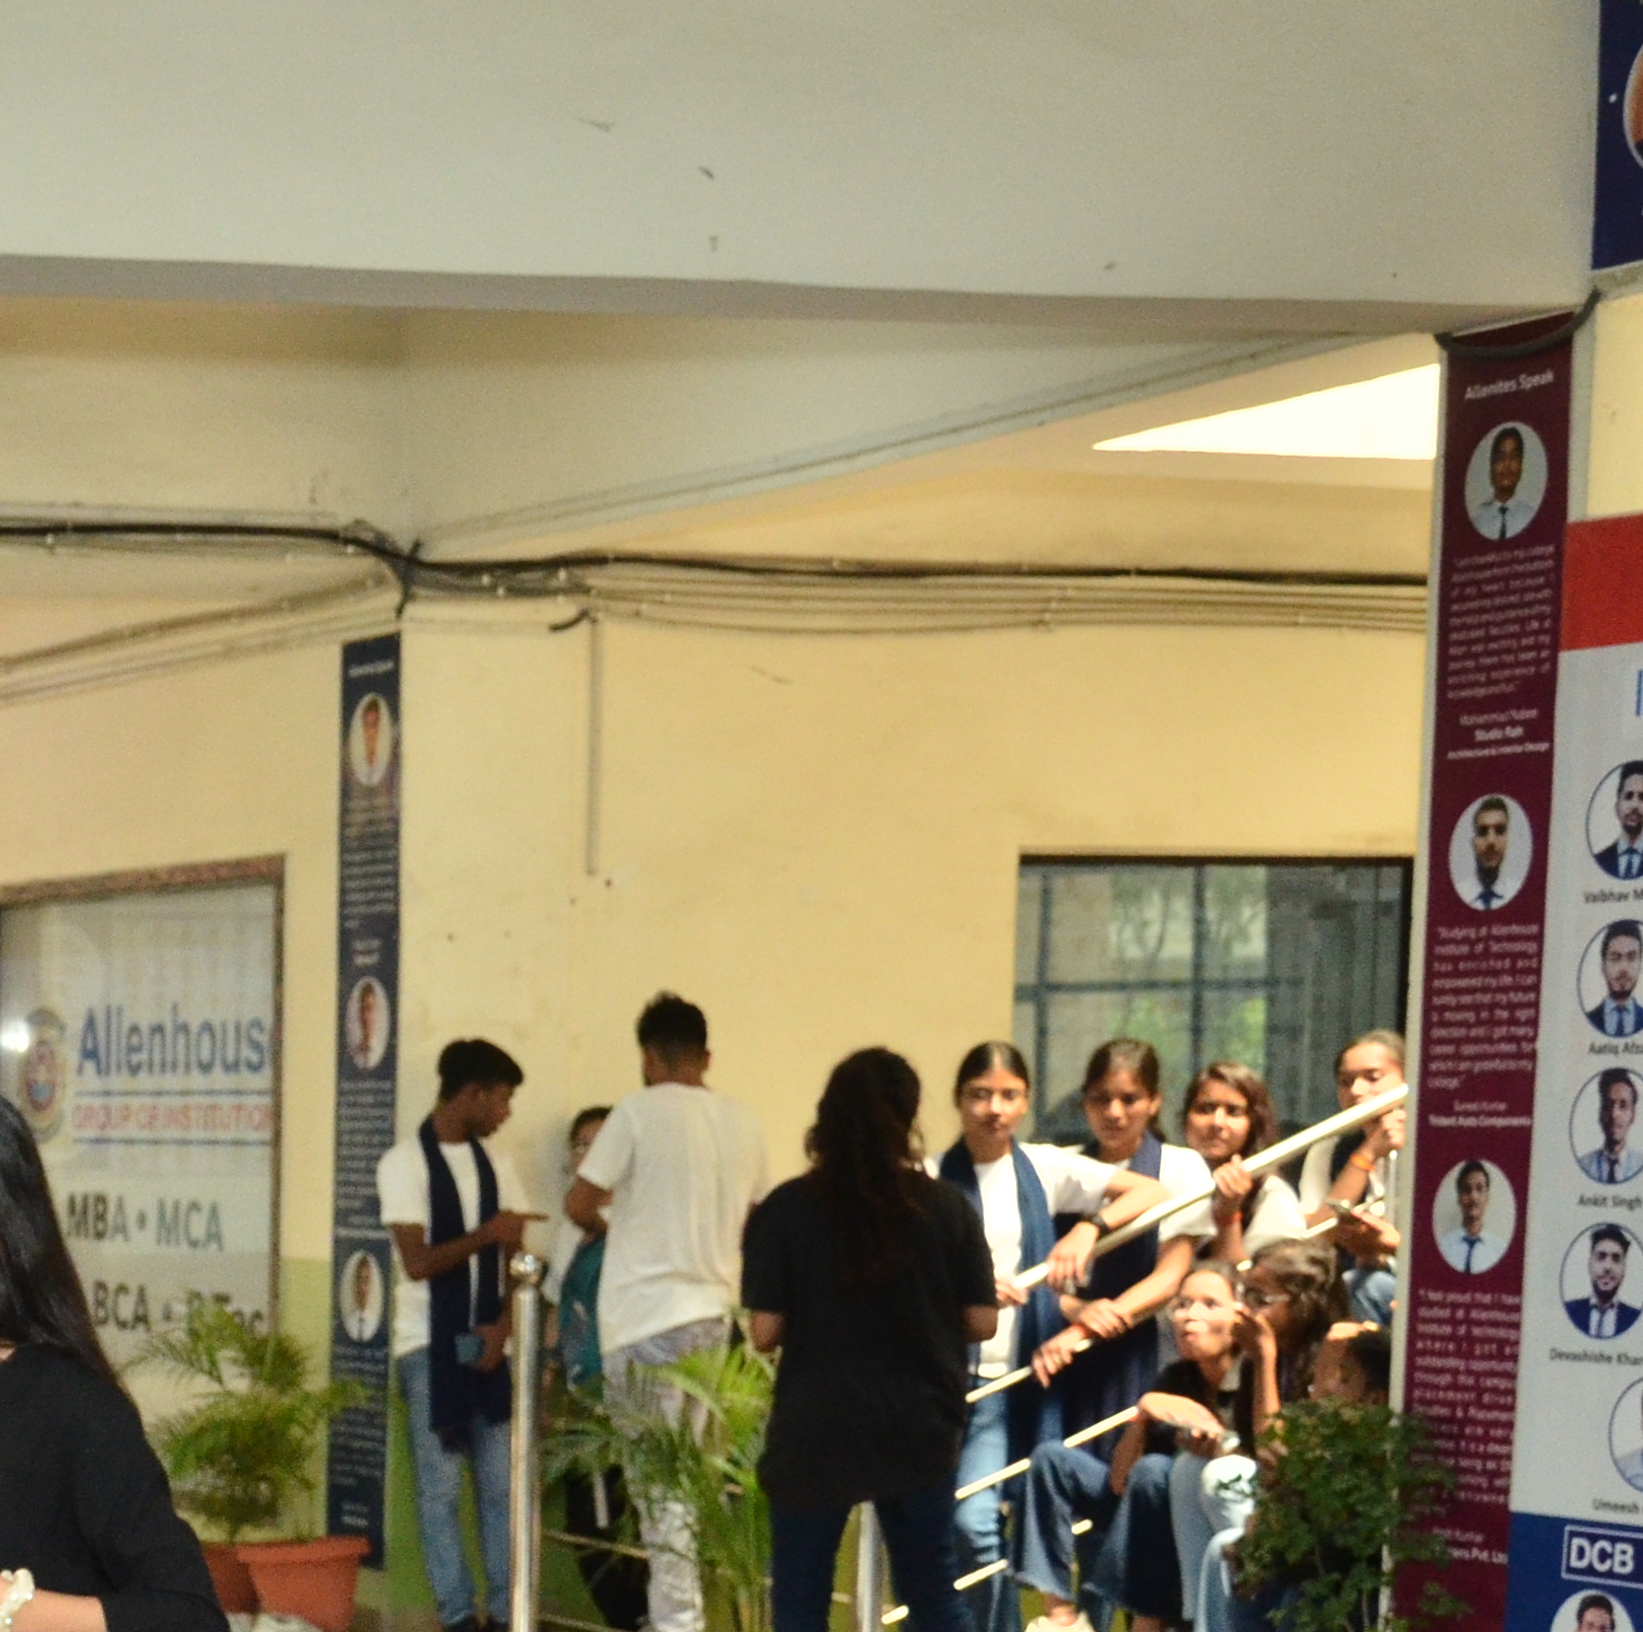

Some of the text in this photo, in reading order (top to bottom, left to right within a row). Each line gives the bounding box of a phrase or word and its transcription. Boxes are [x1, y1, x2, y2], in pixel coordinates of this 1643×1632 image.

[76, 1003, 266, 1077] Allenhous
[66, 1193, 224, 1251] MBA MCA
[93, 1279, 152, 1332] BCA
[1569, 1537, 1634, 1575] DCB
